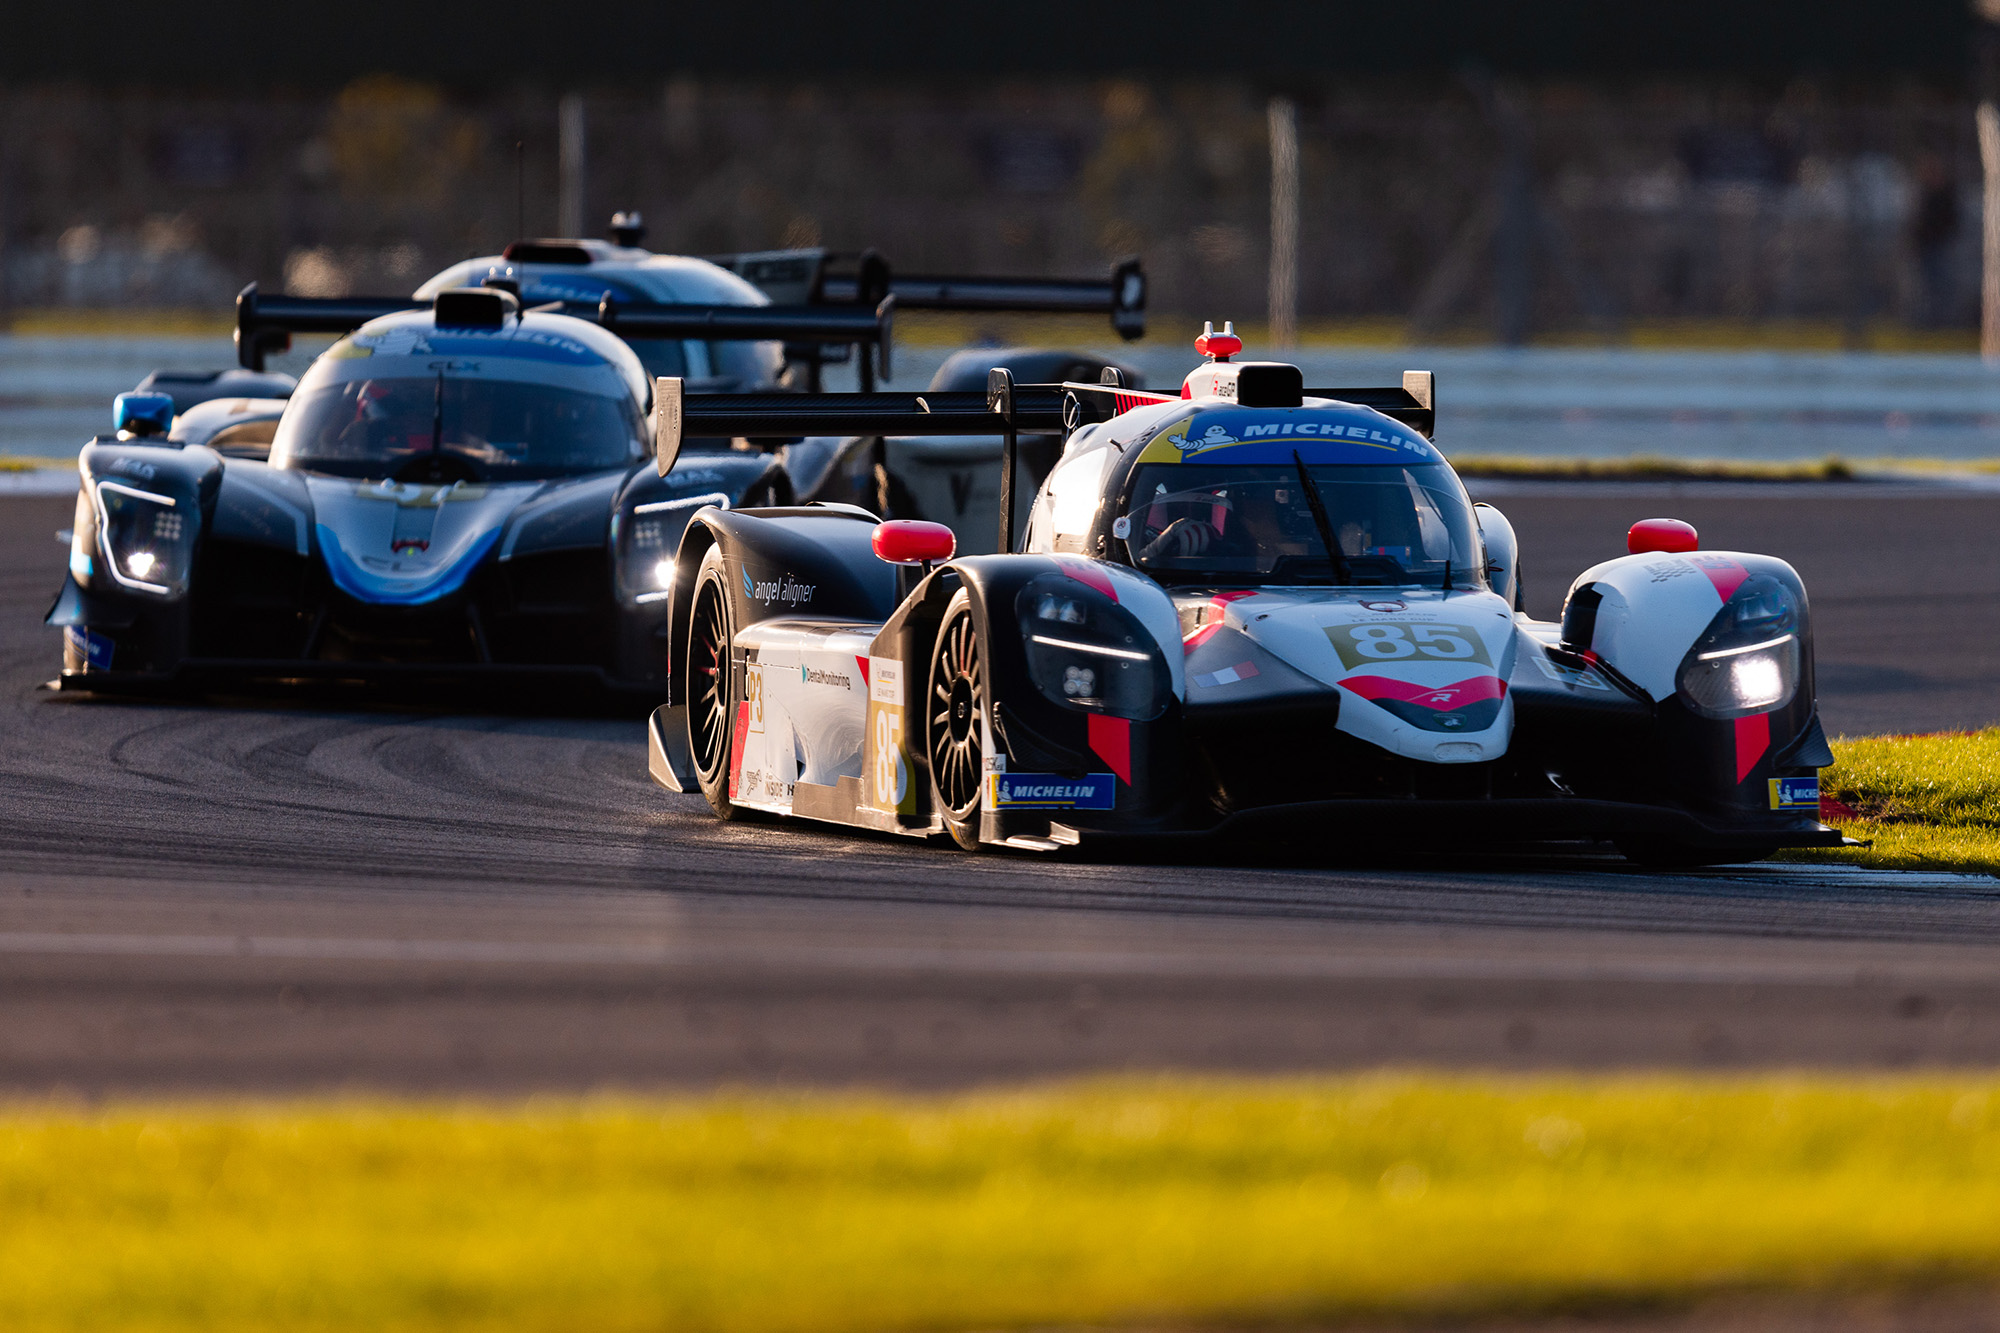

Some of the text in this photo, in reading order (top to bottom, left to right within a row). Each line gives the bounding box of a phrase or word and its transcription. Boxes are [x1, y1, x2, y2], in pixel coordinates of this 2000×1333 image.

[1243, 422, 1429, 457] MICHELIN
[755, 577, 816, 608] angel aligner
[1349, 624, 1475, 659] 85
[806, 667, 851, 690] DentalMonitoring
[750, 671, 763, 723] P3
[876, 710, 908, 805] 85
[1013, 785, 1096, 798] MICHELIN
